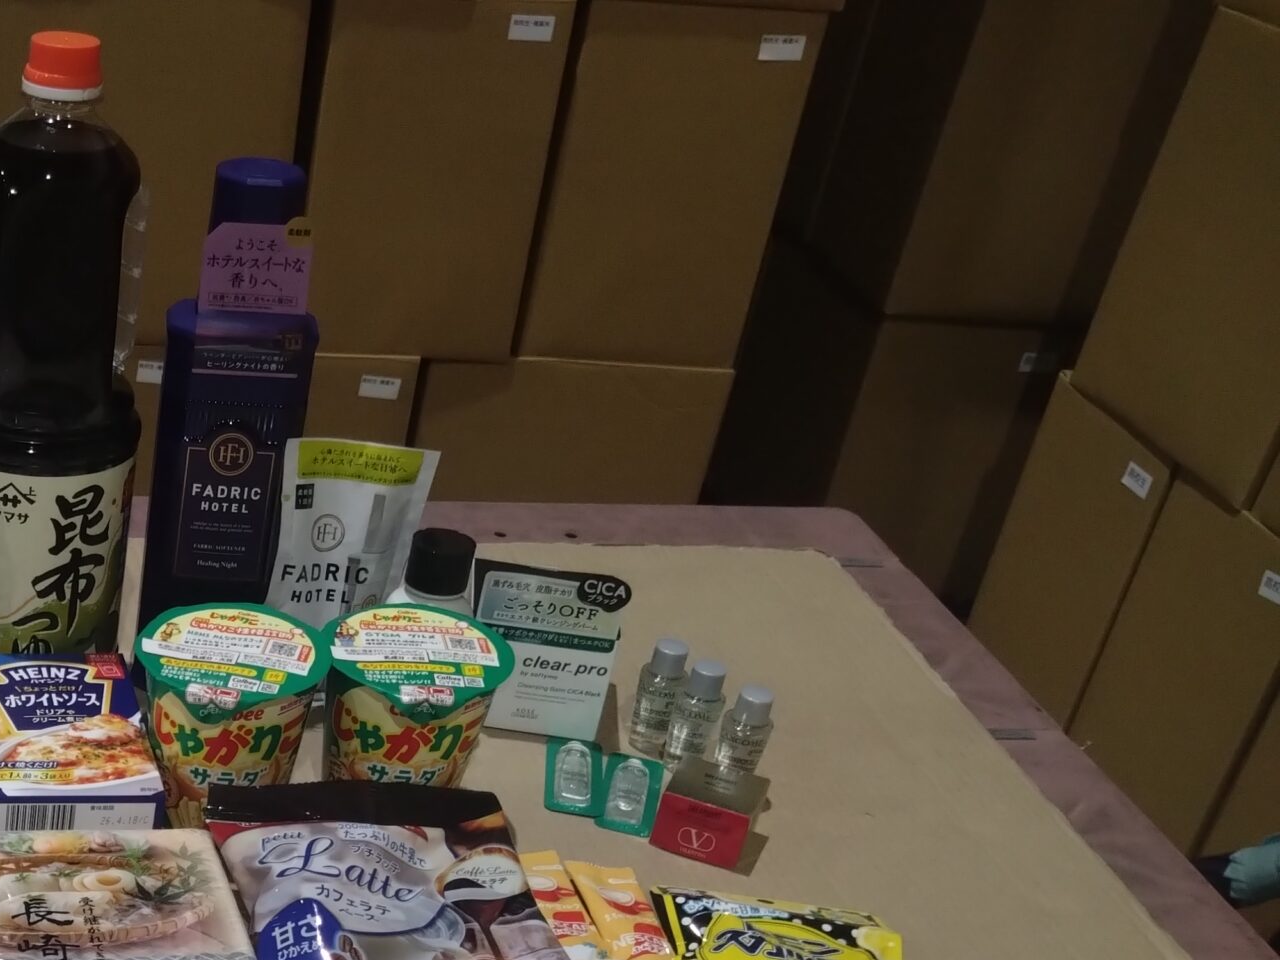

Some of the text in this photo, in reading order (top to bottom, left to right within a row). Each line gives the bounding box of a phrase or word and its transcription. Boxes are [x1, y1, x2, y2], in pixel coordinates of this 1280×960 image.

[206, 255, 306, 273] ホテルスイートな
[191, 483, 261, 500] FADRIC
[201, 501, 249, 514] HOTEL
[281, 562, 369, 585] FADRIC
[290, 589, 351, 605] HOTEL
[584, 579, 627, 600] CICA
[587, 595, 618, 606] ブラック
[9, 666, 82, 682] HEINZ
[4, 693, 101, 708] ホワイトソース
[155, 700, 307, 767] じゃがりこ
[332, 697, 483, 765] じゃがりこ
[190, 767, 268, 788] サラダ
[367, 764, 446, 787] サラダ
[261, 832, 305, 851] petit
[342, 828, 428, 869] たっぷりの牛乳で
[259, 837, 426, 902] Latte
[351, 844, 400, 874] プチラッテ
[315, 884, 392, 916] カフェラテ
[338, 908, 381, 923] ベース
[272, 914, 323, 950] 甘さ
